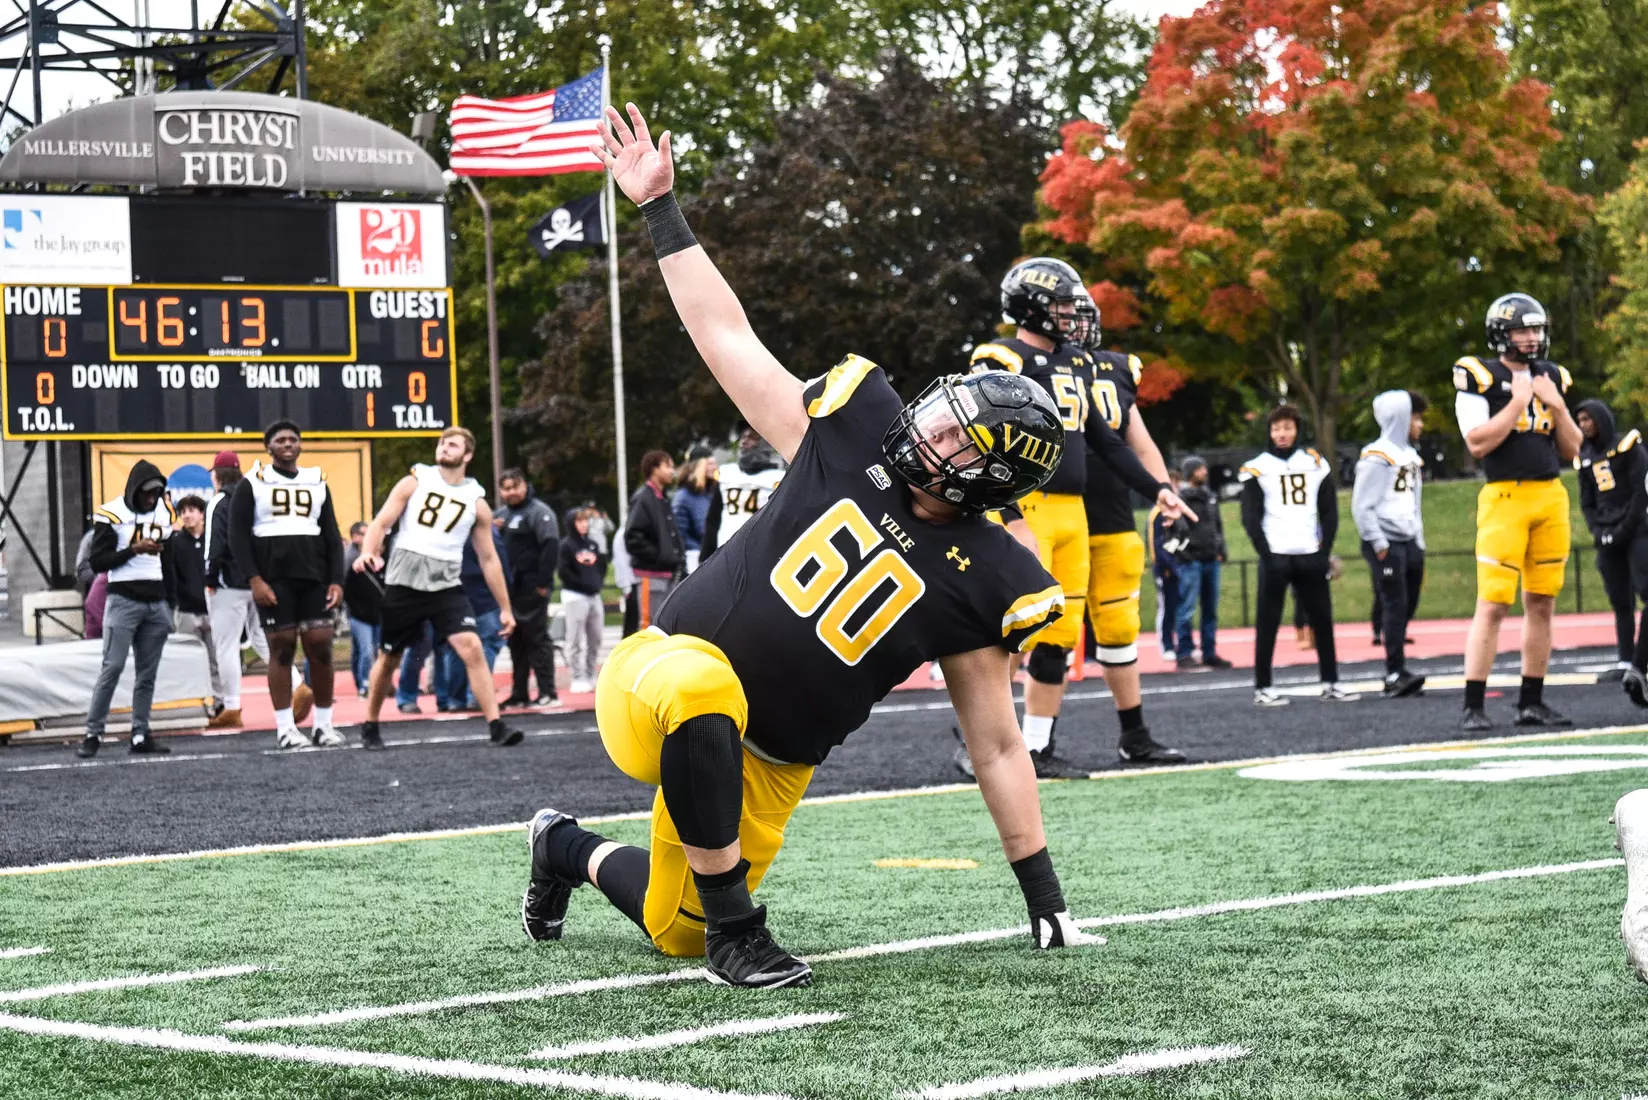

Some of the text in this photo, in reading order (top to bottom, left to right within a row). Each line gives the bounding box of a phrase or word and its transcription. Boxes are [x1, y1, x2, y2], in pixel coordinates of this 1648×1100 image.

[159, 110, 297, 149] CHRYST
[24, 140, 153, 158] MILLERSVILLE
[312, 145, 416, 165] UNIVERSITY
[182, 151, 288, 188] FIELD
[34, 235, 57, 250] the
[83, 239, 126, 255] group
[1017, 269, 1060, 291] VILLE
[4, 287, 82, 316] HOME
[370, 291, 448, 318] GUEST
[43, 318, 67, 358] 0
[36, 372, 55, 405] 0
[72, 365, 138, 388] DOWN
[157, 365, 220, 388] TO GO
[247, 365, 320, 388] BALL ON
[342, 365, 382, 388] QTR
[408, 372, 427, 403] 0
[366, 392, 375, 428] 1
[392, 406, 444, 428] T.O.L.
[1051, 374, 1089, 432] 51
[18, 407, 75, 431] T.O.L.
[1003, 422, 1061, 471] VILLE
[872, 466, 889, 488] PSAC
[1279, 473, 1307, 505] 18
[271, 487, 313, 518] 99
[417, 491, 467, 533] 87
[725, 487, 761, 516] 84
[880, 512, 916, 553] VILLE
[769, 497, 926, 667] 60
